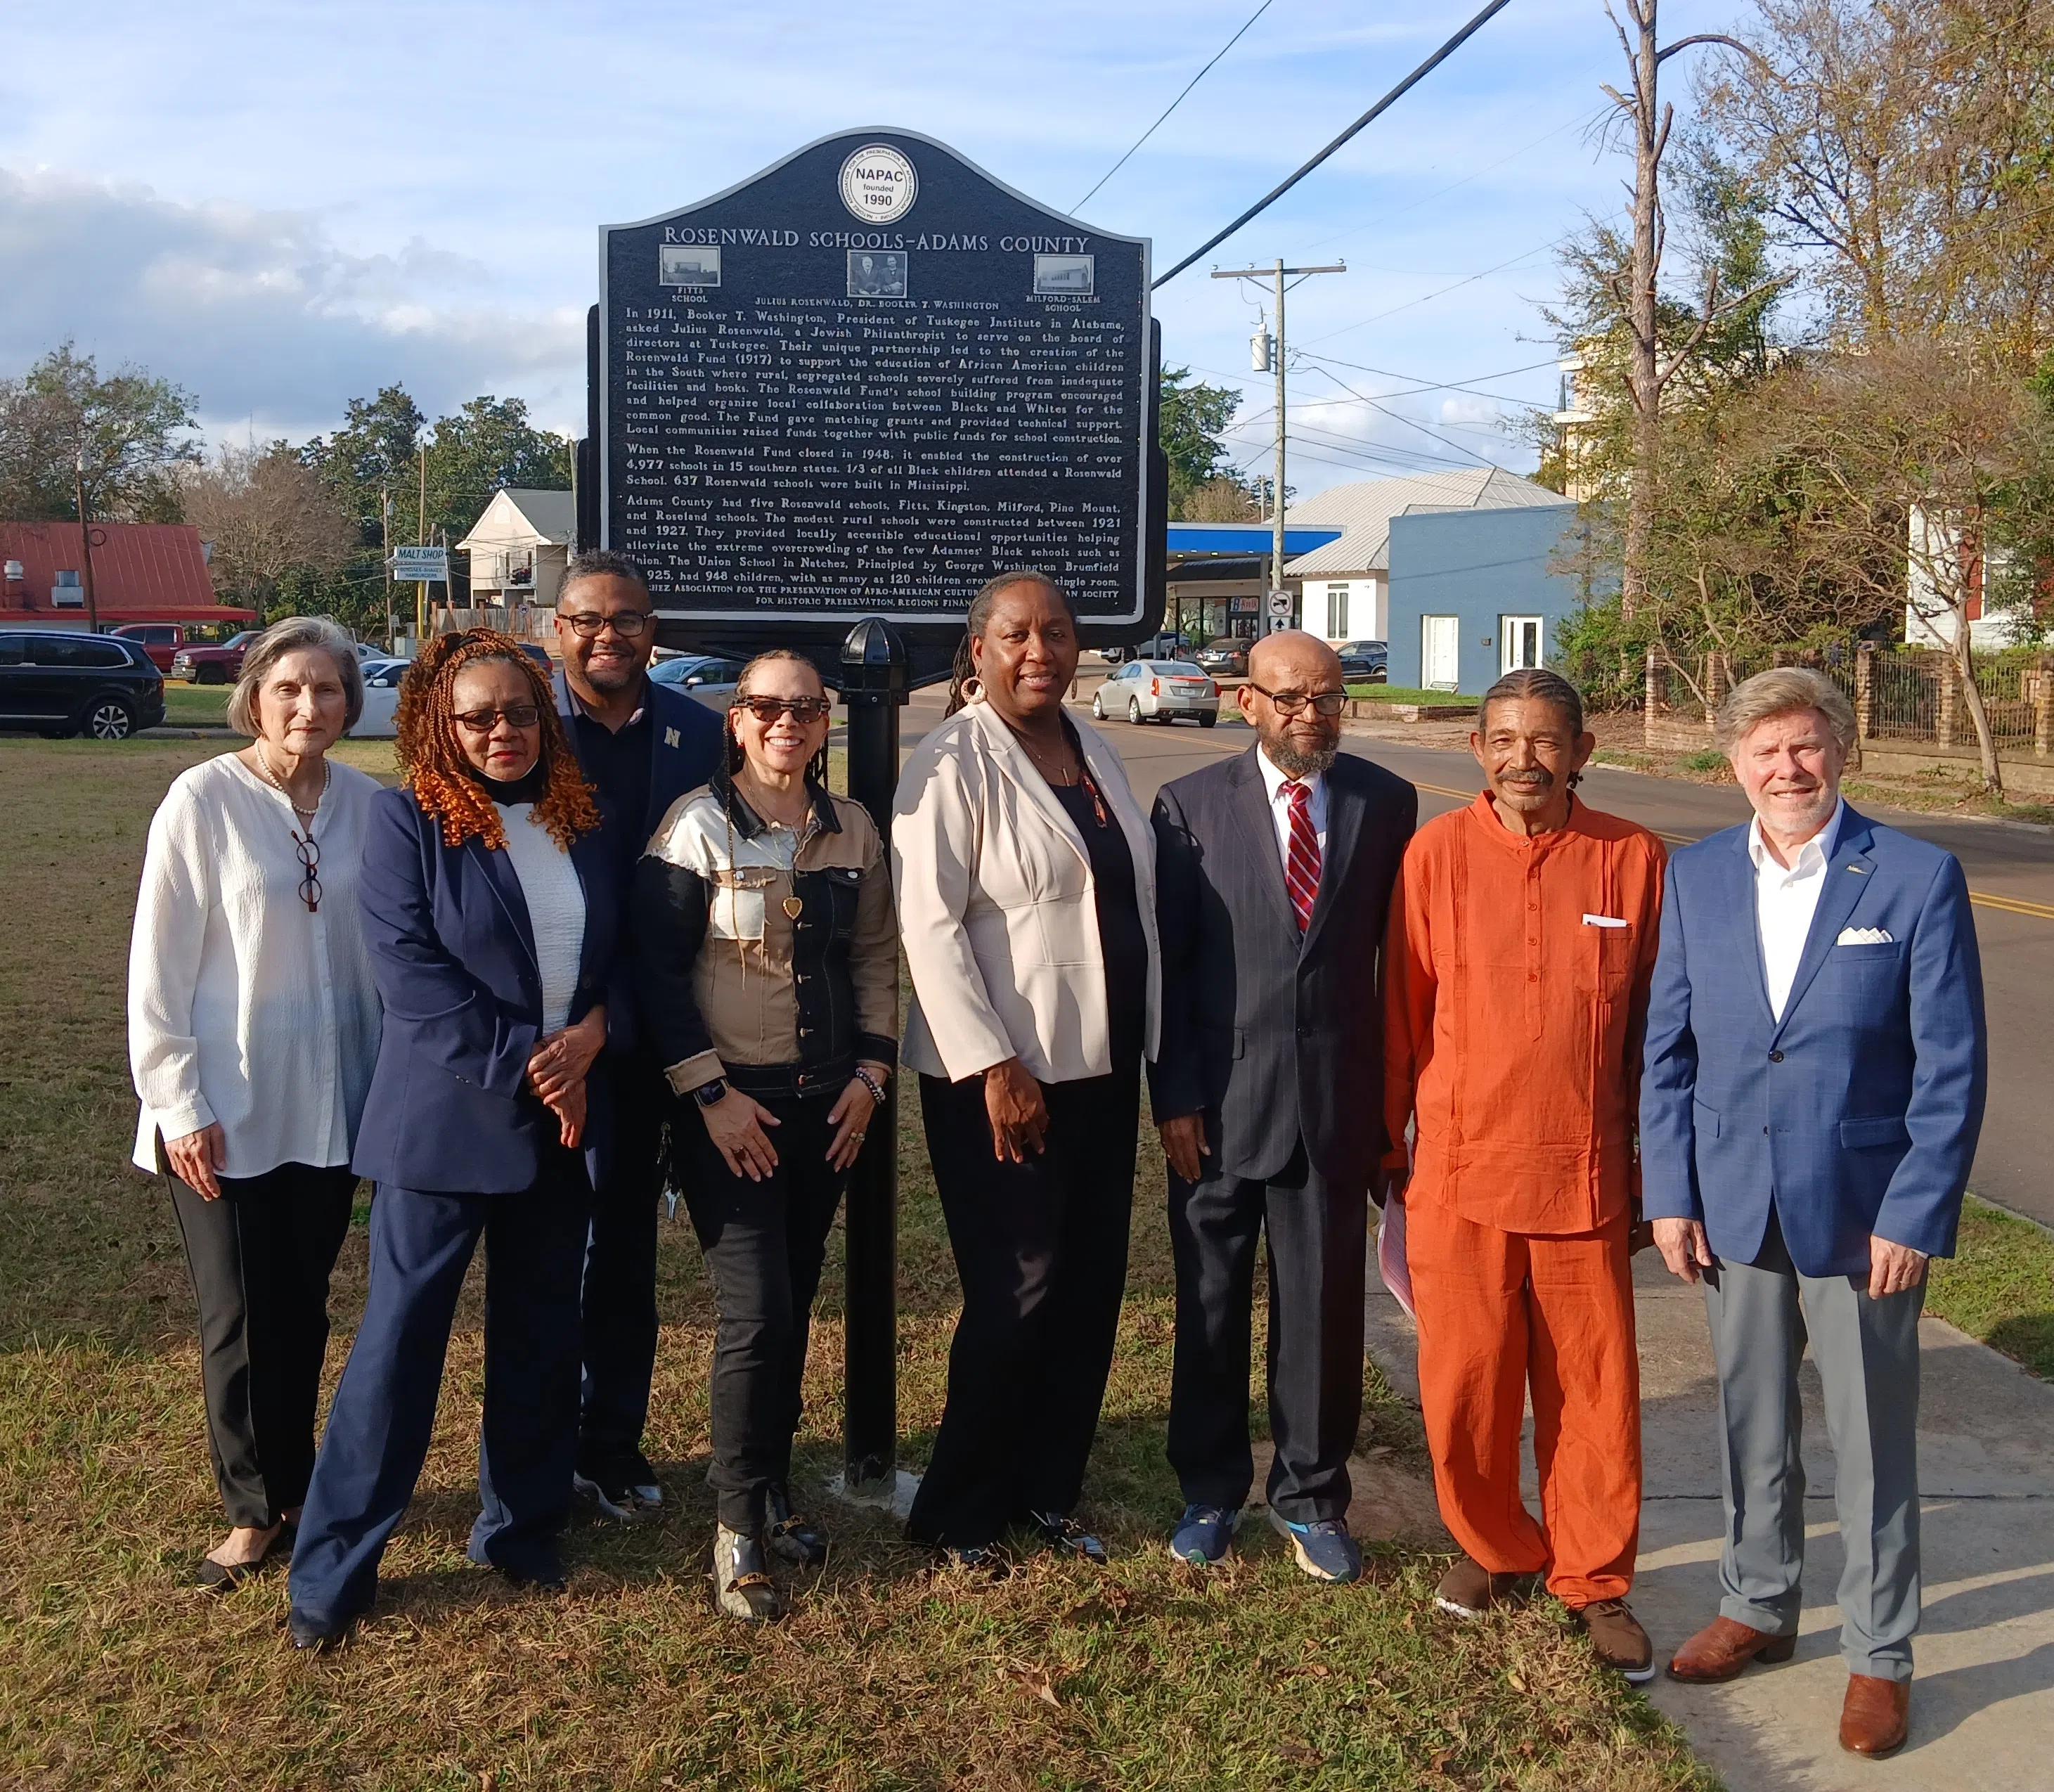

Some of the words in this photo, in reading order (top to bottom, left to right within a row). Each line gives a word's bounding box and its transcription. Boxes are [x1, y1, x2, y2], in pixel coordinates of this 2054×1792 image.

[856, 168, 903, 182] NAPAC
[863, 183, 894, 193] founded
[863, 194, 892, 206] 1990
[664, 227, 799, 245] ROSENWALD
[810, 232, 988, 250] SCHOOLS-ADAMS
[1000, 236, 1088, 254] COUNTY
[755, 297, 786, 306] JULIUS
[858, 299, 876, 308] DR.
[934, 300, 998, 309] WASHINGTON
[1025, 295, 1101, 303] MILFORD-SALEM
[1045, 304, 1081, 312] SCHOOL
[627, 307, 638, 318] In
[648, 308, 676, 320] 1911,
[687, 308, 727, 320] Booker
[735, 310, 747, 321] T.
[755, 311, 827, 325] Washington,
[837, 312, 896, 324] President
[905, 316, 918, 325] of
[926, 314, 980, 328] Tuskegee
[990, 316, 1040, 328] Institute
[1050, 318, 1061, 328] in
[1071, 318, 1125, 330] Alabama,
[626, 323, 659, 333] asked
[671, 323, 707, 333] Julius
[718, 323, 783, 336] Rosenwald,
[810, 326, 852, 337] Jewish
[863, 328, 946, 342] Philanthropist
[956, 332, 969, 340] to
[1043, 333, 1060, 342] the
[1068, 333, 1102, 343] board
[1112, 334, 1125, 344] of
[626, 337, 680, 348] directors
[689, 340, 702, 348] at
[710, 338, 770, 352] Tuskegee.
[779, 340, 813, 351] Their
[822, 342, 860, 354] unique
[872, 344, 941, 356] partnership
[950, 345, 969, 354] led
[978, 347, 991, 355] to
[1001, 347, 1019, 356] the
[1031, 347, 1077, 356] creation
[1085, 348, 1098, 356] of
[1105, 349, 1123, 357] the
[626, 351, 689, 363] Rosenwald
[697, 352, 725, 363] Fund
[735, 354, 772, 365] (1917)
[780, 356, 792, 365] to
[799, 358, 842, 368] support
[849, 357, 867, 367] the
[874, 358, 931, 368] education
[938, 359, 950, 368] of
[959, 359, 1002, 369] African
[1011, 360, 1067, 370] American
[1076, 361, 1123, 372] children
[627, 380, 678, 391] facilities
[686, 382, 706, 392] and
[716, 383, 749, 392] books.
[758, 382, 779, 394] The
[789, 383, 851, 395] Rosenwald
[860, 385, 898, 397] Fund's
[907, 387, 941, 397] school
[950, 387, 997, 401] building
[1007, 391, 1053, 401] program
[1061, 392, 1123, 402] encouraged
[627, 396, 647, 405] and
[658, 396, 696, 408] helped
[709, 397, 758, 409] organize
[768, 399, 796, 408] local
[806, 399, 884, 410] collaboration
[893, 401, 942, 411] between
[952, 401, 988, 412] Blacks
[997, 404, 1016, 413] and
[1026, 403, 1067, 413] Whites
[1076, 404, 1094, 414] for
[1104, 405, 1123, 415] the
[680, 412, 710, 423] good.
[717, 411, 739, 422] The
[748, 411, 779, 423] Fund
[787, 415, 814, 425] gave
[825, 415, 879, 427] matching
[887, 418, 924, 427] grants
[931, 417, 950, 425] and
[960, 417, 1009, 429] provided
[1018, 418, 1067, 427] technical
[1077, 421, 1122, 431] support.
[627, 443, 659, 454] When
[666, 446, 686, 454] the
[695, 444, 754, 456] Rosenwald
[763, 446, 790, 457] Fund
[799, 448, 834, 458] closed
[842, 448, 852, 458] in
[903, 449, 912, 459] it
[921, 451, 963, 460] enabled
[971, 451, 990, 460] the
[998, 452, 1068, 462] construction
[1077, 453, 1088, 462] of
[626, 475, 666, 485] School.
[673, 475, 697, 485] 637
[706, 475, 766, 487] Rosenwald
[773, 479, 813, 488] schools
[855, 479, 883, 489] built
[890, 480, 900, 489] in
[908, 480, 970, 493] Mississippi.
[627, 494, 664, 505] Adams
[672, 496, 713, 510] County
[723, 497, 742, 507] had
[751, 497, 773, 508] five
[782, 498, 841, 508] Rosenwald
[1049, 502, 1074, 513] Pine
[398, 549, 420, 559] MALT
[422, 550, 444, 560] SHOP
[675, 584, 732, 593] ASSOCIATION
[865, 587, 941, 595] AFRO-AMERICAN
[755, 596, 775, 605] FOR
[898, 598, 938, 607] REGIONS
